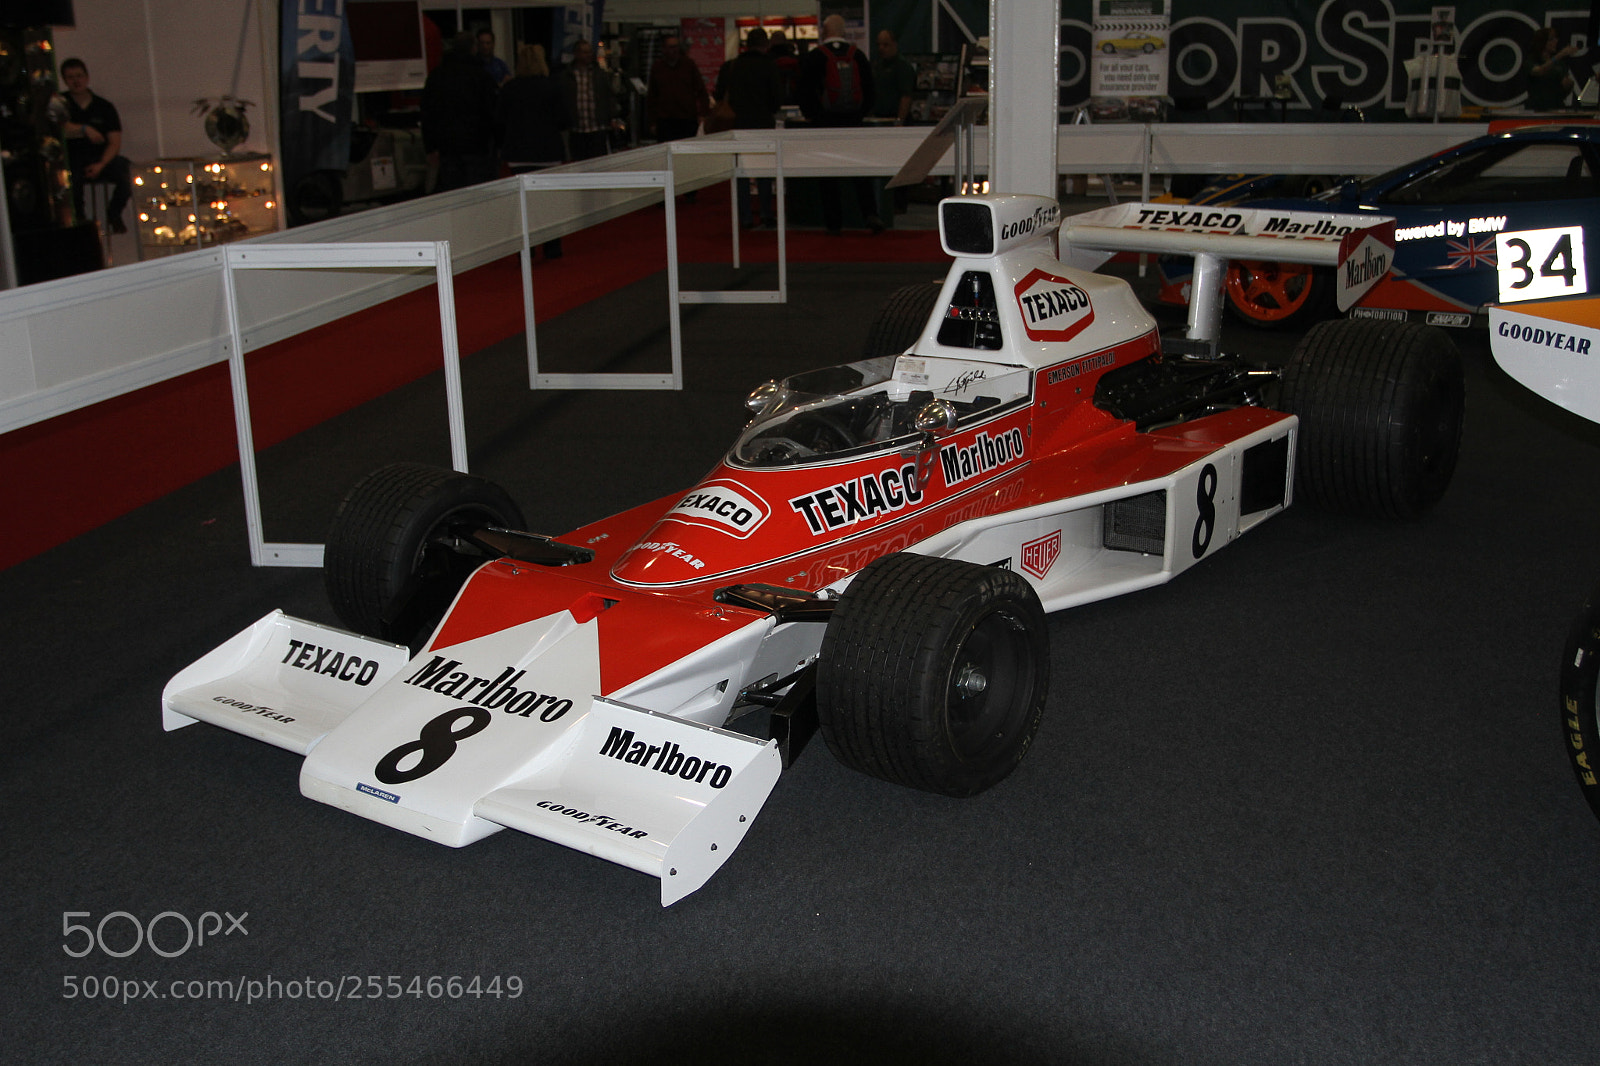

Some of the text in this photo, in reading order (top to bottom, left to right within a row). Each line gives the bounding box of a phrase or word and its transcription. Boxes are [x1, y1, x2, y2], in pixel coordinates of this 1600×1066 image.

[1104, 74, 1116, 83] you
[1119, 64, 1133, 74] your
[1137, 209, 1242, 229] TEXACO
[1395, 215, 1508, 242] owered by BMW
[1345, 245, 1386, 290] Marlboro
[1505, 233, 1577, 290] 34
[1022, 283, 1088, 324] TEXACO
[1498, 321, 1592, 356] GOODYEAR
[1047, 351, 1116, 385] EMERSON FITTIPALDI
[940, 427, 1024, 488] Marlboro
[678, 493, 753, 527] EXACO
[788, 462, 924, 536] TEXACO
[1192, 463, 1218, 560] 8
[1025, 539, 1059, 572] HEUER
[281, 639, 380, 687] TEXACO
[403, 655, 574, 723] Marlboro
[212, 695, 296, 725] GOODYEAR
[374, 706, 492, 785] 8
[599, 726, 733, 789] Marlboro
[1566, 695, 1598, 786] EAGLE
[536, 800, 649, 840] GOODYEAR
